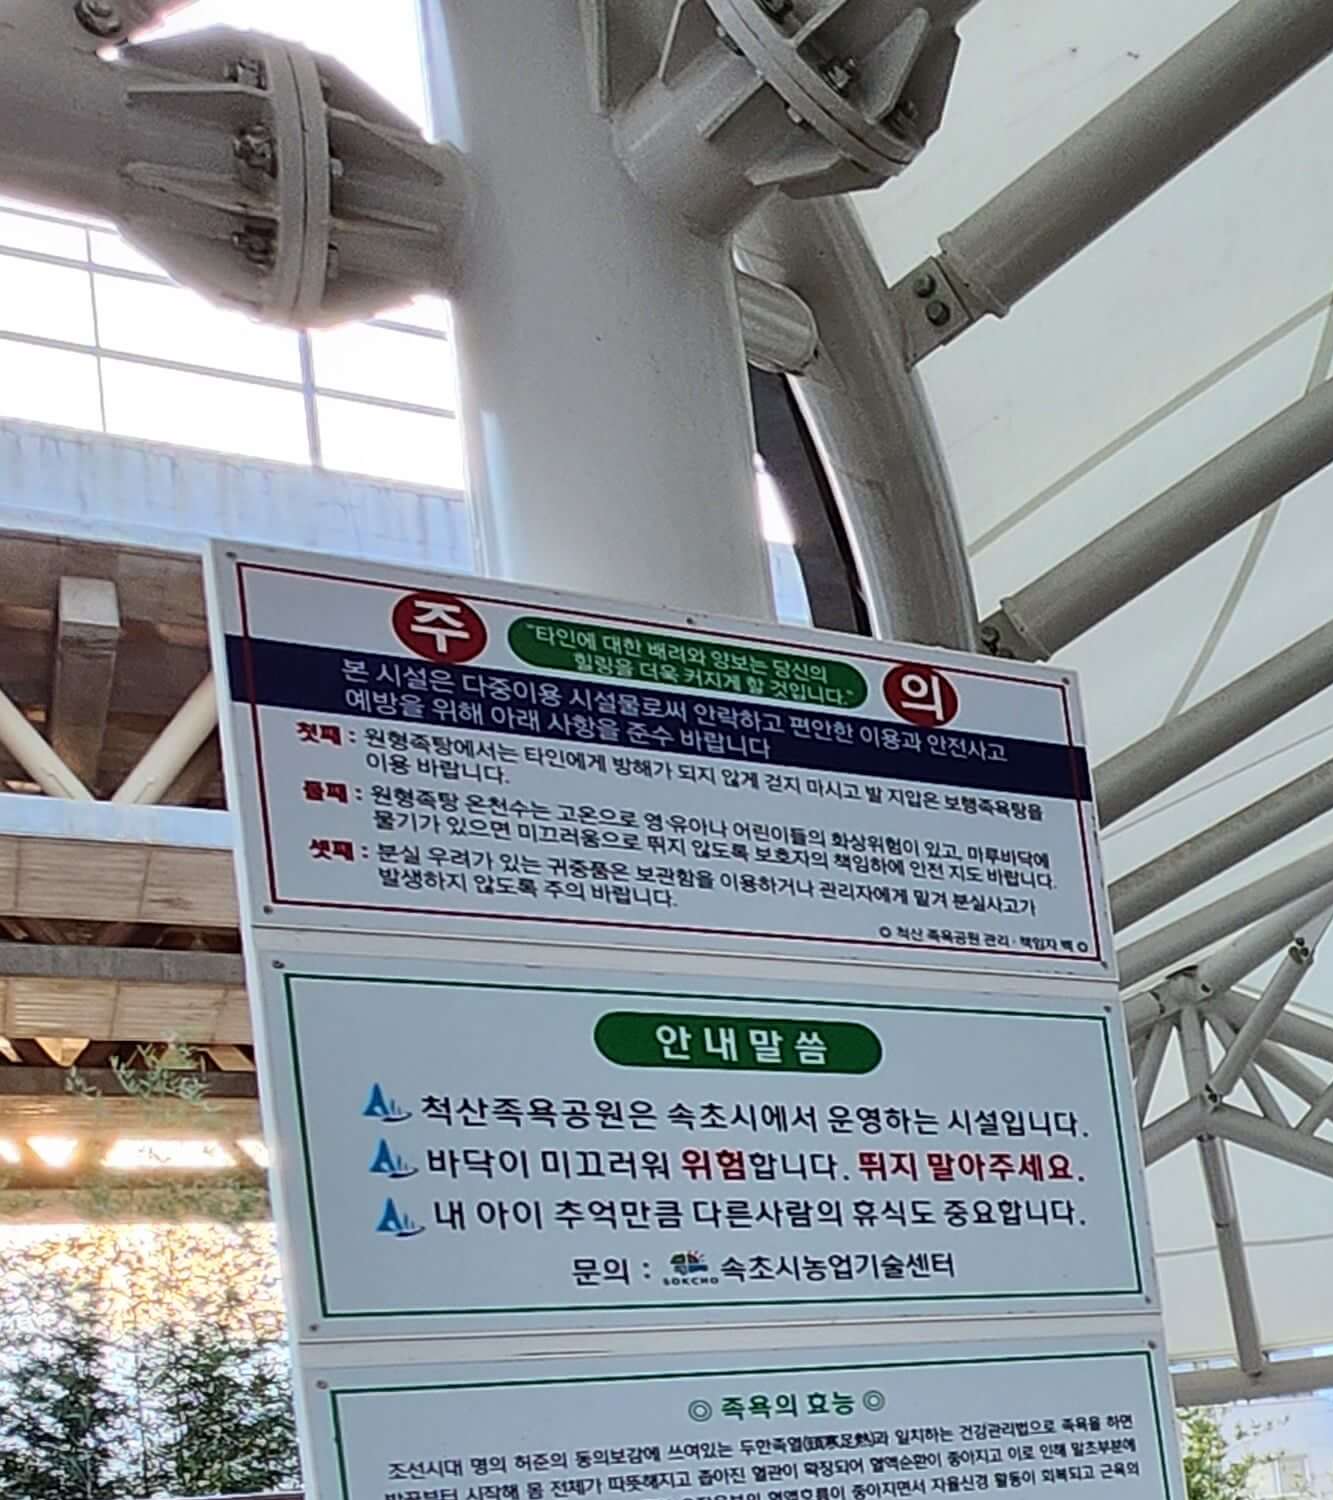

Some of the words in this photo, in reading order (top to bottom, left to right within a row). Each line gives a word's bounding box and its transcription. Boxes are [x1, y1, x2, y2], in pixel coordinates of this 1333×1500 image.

[409, 598, 472, 654] 주
[600, 634, 643, 659] 대한
[771, 658, 828, 685] 당신의
[638, 661, 680, 684] 더욱
[682, 666, 742, 693] 커지게
[745, 674, 765, 696] 할
[340, 657, 370, 684] 본
[375, 662, 456, 695] 시설은
[461, 673, 563, 708] 다중이용
[568, 687, 688, 724] 시설물로써
[692, 702, 786, 734] 안락하고
[787, 714, 854, 745] 편안한
[858, 724, 923, 753] 이용과
[925, 733, 1009, 763] 안전사고
[898, 670, 947, 719] 의
[344, 687, 425, 719] 예방을
[430, 697, 485, 726] 위해
[489, 705, 541, 733] 아래
[546, 711, 621, 743] 사항을
[625, 720, 675, 748] 준수
[678, 727, 771, 760] 바랍니다
[295, 720, 343, 747] 첫째
[363, 726, 520, 764] 원형족탕에서는
[523, 745, 608, 774] 타인에게
[611, 755, 673, 781] 방해가
[676, 763, 717, 786] 되지
[720, 768, 760, 791] 않게
[764, 772, 802, 795] 걷지
[805, 778, 862, 800] 마시고
[864, 784, 883, 805] 발
[886, 787, 941, 811] 지압은
[365, 752, 412, 776] 이용
[415, 757, 515, 786] 바랍니다.
[301, 778, 349, 805] 둘째
[369, 784, 460, 813] 원형족탕
[464, 793, 552, 822] 온천수는
[556, 803, 640, 829] 고온으로
[732, 821, 827, 849] 어린이들의
[830, 830, 921, 858] 화상위험이
[966, 845, 1050, 870] 마루바닥에
[308, 837, 355, 862] 셋째
[376, 842, 421, 866] 분실
[426, 846, 494, 872] 우려가
[498, 852, 542, 876] 있는
[634, 865, 715, 890] 보관함을
[718, 872, 815, 898] 이용하거나
[818, 880, 909, 906] 관리자에게
[372, 808, 441, 835] 물기가
[444, 815, 512, 842] 있으면
[516, 822, 643, 851] 미끄러움으로
[646, 834, 687, 857] 뛰지
[690, 838, 749, 863] 않도록
[753, 845, 830, 870] 보호자의
[832, 852, 906, 877] 책임하에
[908, 859, 945, 881] 안전
[948, 864, 984, 883] 지도
[985, 867, 1058, 892] 바랍니다.
[377, 866, 468, 894] 발생하지
[472, 873, 538, 899] 않도록
[543, 878, 586, 902] 주의
[589, 883, 678, 910] 바랍니다.
[420, 1094, 658, 1130] 척산족욕공원은
[666, 1102, 818, 1134] 속초시에서
[826, 1104, 940, 1136] 운영하는
[946, 1108, 1089, 1138] 시설입니다.
[426, 1148, 530, 1180] 바닥이
[540, 1149, 671, 1181] 미끄러워
[680, 1148, 850, 1181] 위험합니다.
[857, 1151, 919, 1182] 뛰지
[926, 1152, 1085, 1183] 말아주세요.
[432, 1200, 466, 1231] 내
[475, 1200, 543, 1231] 아이
[554, 1199, 684, 1230] 추억만큼
[691, 1199, 843, 1229] 다른사람의
[852, 1198, 937, 1228] 휴식도
[942, 1198, 1086, 1228] 중요합니다.
[571, 1257, 630, 1287] 문의
[662, 1276, 720, 1286] SOKCHO
[719, 1252, 955, 1283] 속초시농업기술센터
[720, 1392, 799, 1422] 족욕의
[806, 1390, 855, 1416] 효능
[387, 1458, 464, 1481] 조선시대
[469, 1454, 508, 1476] 명의
[513, 1451, 569, 1472] 허준의
[574, 1445, 662, 1470] 동의보감에
[667, 1440, 733, 1461] 쓰여있는
[958, 1418, 1057, 1442] 건강관리법으로
[1105, 1413, 1134, 1430] 하면
[1099, 1460, 1140, 1480] 근육의
[526, 1480, 544, 1500] 몸
[549, 1477, 603, 1499] 전체가
[606, 1470, 692, 1493] 따뜻해지고
[1006, 1444, 1036, 1462] 이로
